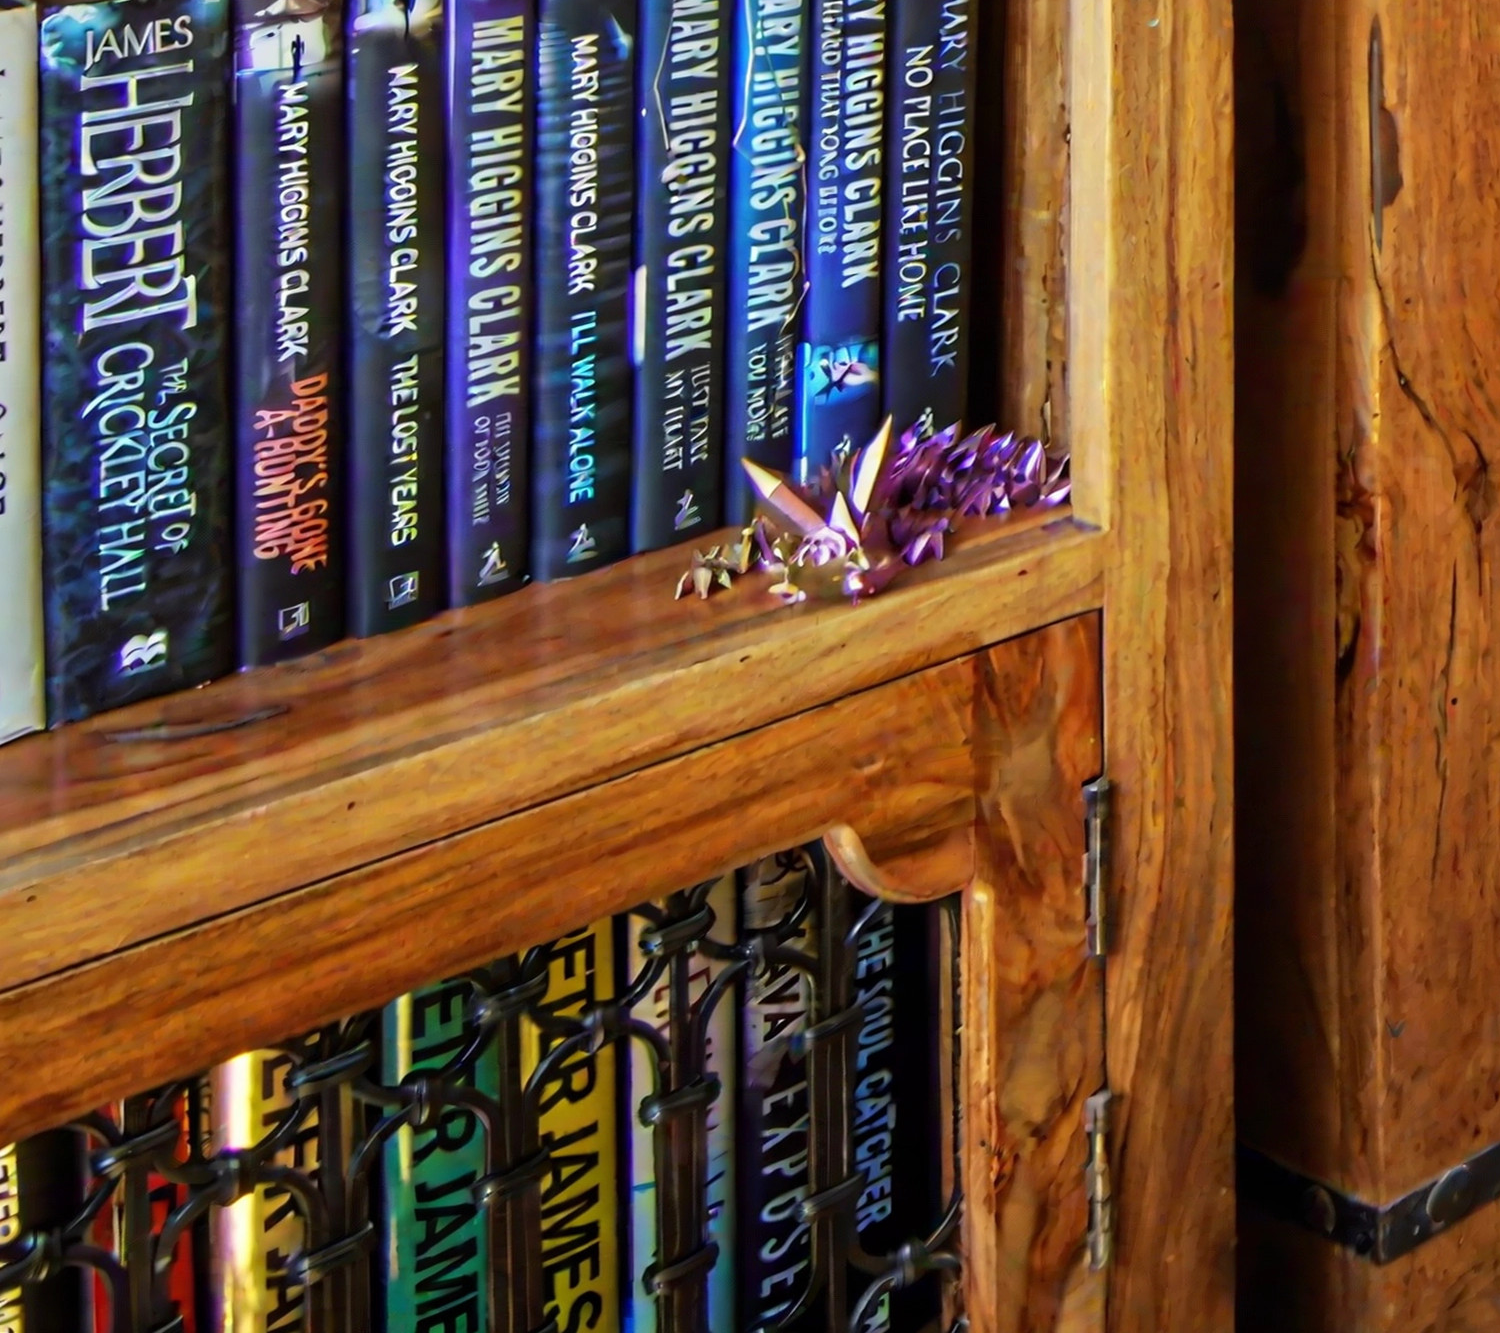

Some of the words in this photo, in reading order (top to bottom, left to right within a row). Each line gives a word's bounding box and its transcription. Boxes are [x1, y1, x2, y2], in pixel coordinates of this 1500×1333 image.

[85, 15, 193, 69] JAMES
[470, 14, 524, 113] MARY
[570, 34, 598, 103] MARY
[279, 82, 309, 163] MARY
[387, 63, 418, 133] MARY
[843, 32, 884, 172] HIGGINS
[79, 60, 197, 333] HERBERT
[386, 139, 418, 241] HIGGINS
[468, 125, 523, 277] HIGGINS
[570, 108, 598, 209] HIGGINS
[668, 91, 719, 238] HIGGINS
[937, 89, 965, 243] HIGGINS
[279, 164, 309, 265] HIGGINS
[568, 212, 598, 294] CLARK
[842, 177, 881, 288] CLARK
[278, 270, 309, 362] CLARK
[387, 246, 419, 337] CLARK
[664, 244, 715, 361] CLARK
[930, 263, 961, 377] CLARK
[467, 284, 521, 408] CLARK
[570, 356, 596, 420] WALK
[82, 343, 153, 513] CRICKLEY
[568, 422, 596, 504] ALONE
[98, 517, 146, 612] HALL
[850, 1068, 893, 1233] CATCHER
